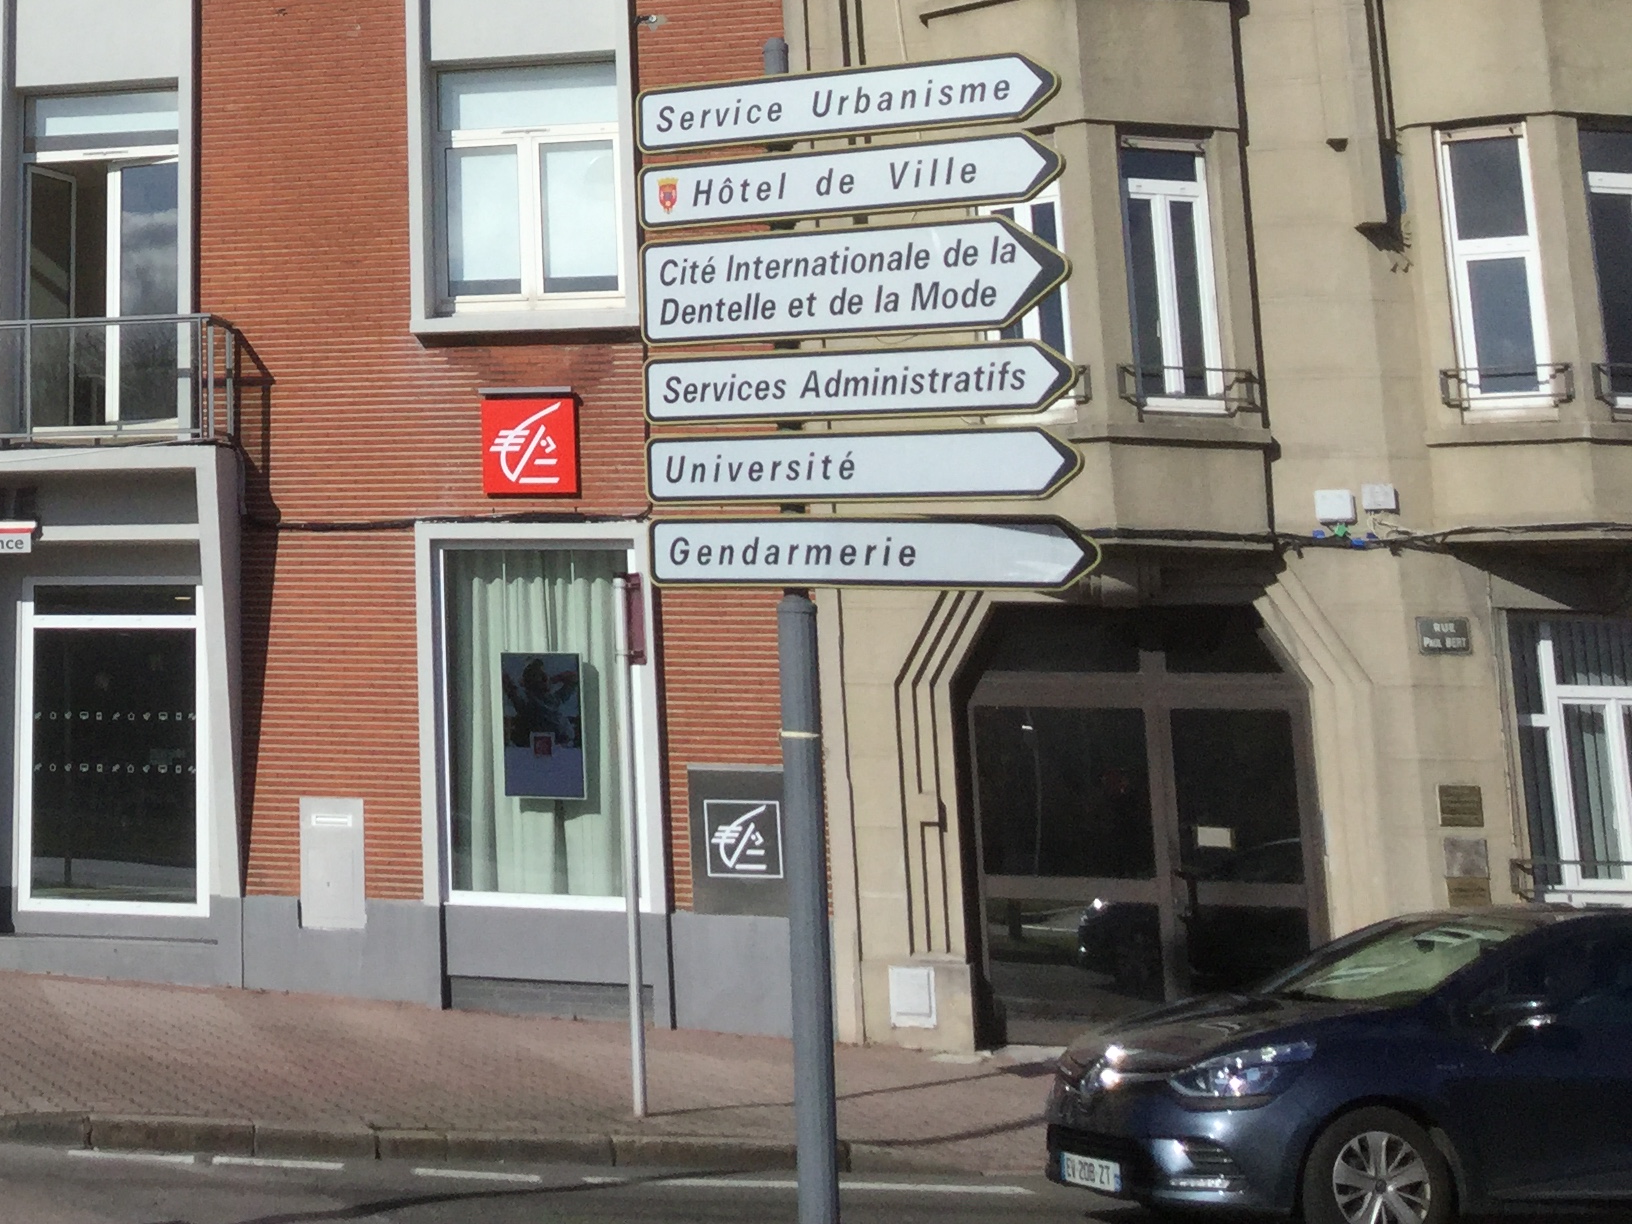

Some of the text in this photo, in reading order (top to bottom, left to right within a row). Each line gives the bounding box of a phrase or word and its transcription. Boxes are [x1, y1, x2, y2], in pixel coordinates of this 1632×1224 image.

[656, 78, 1011, 133] Service Urbanisme
[692, 156, 977, 207] Hôtel de Ville
[659, 236, 1017, 287] Cité Internationale de la
[659, 278, 997, 326] Dentelle et de la Mode
[662, 360, 1027, 404] Services Administratifs
[665, 450, 856, 484] Université
[669, 536, 917, 567] Gendarmerie
[1433, 622, 1456, 633] RUE
